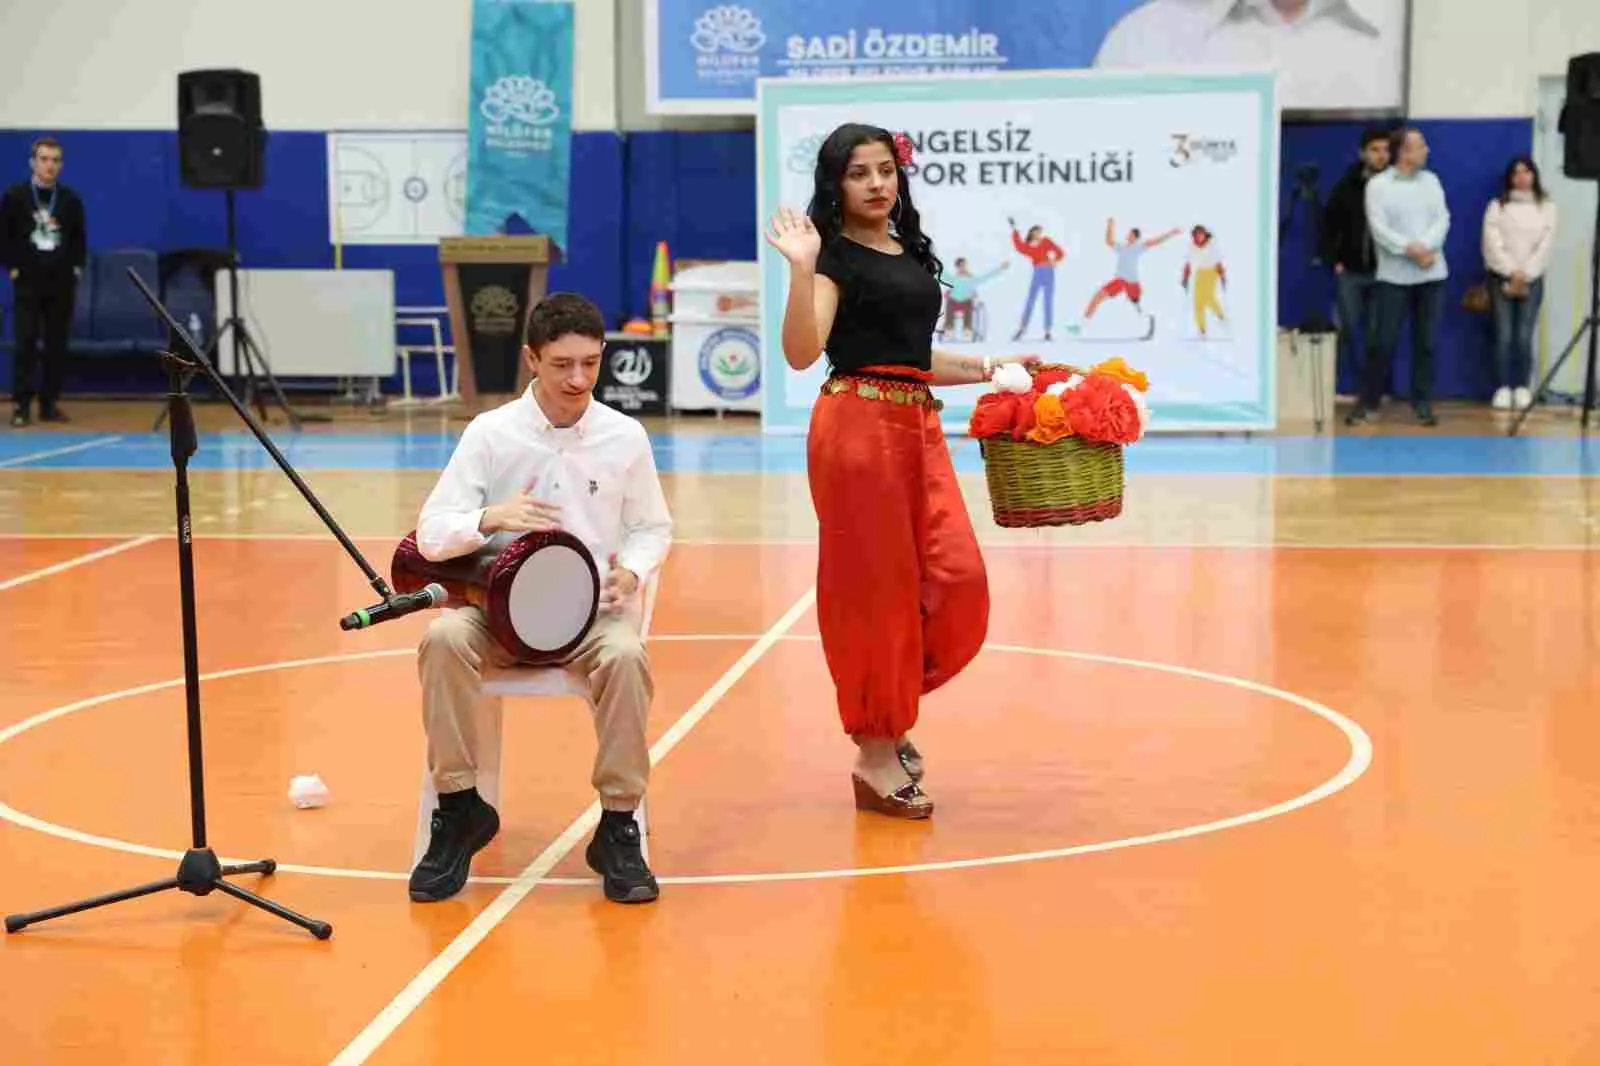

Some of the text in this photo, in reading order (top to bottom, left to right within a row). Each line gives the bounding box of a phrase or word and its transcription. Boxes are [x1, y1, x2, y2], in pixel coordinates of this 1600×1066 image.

[787, 27, 1000, 59] SADİ ÖZDEMİR
[889, 121, 1032, 153] NGELSİZ
[904, 151, 1134, 185] POR ETKİNLİĞİ
